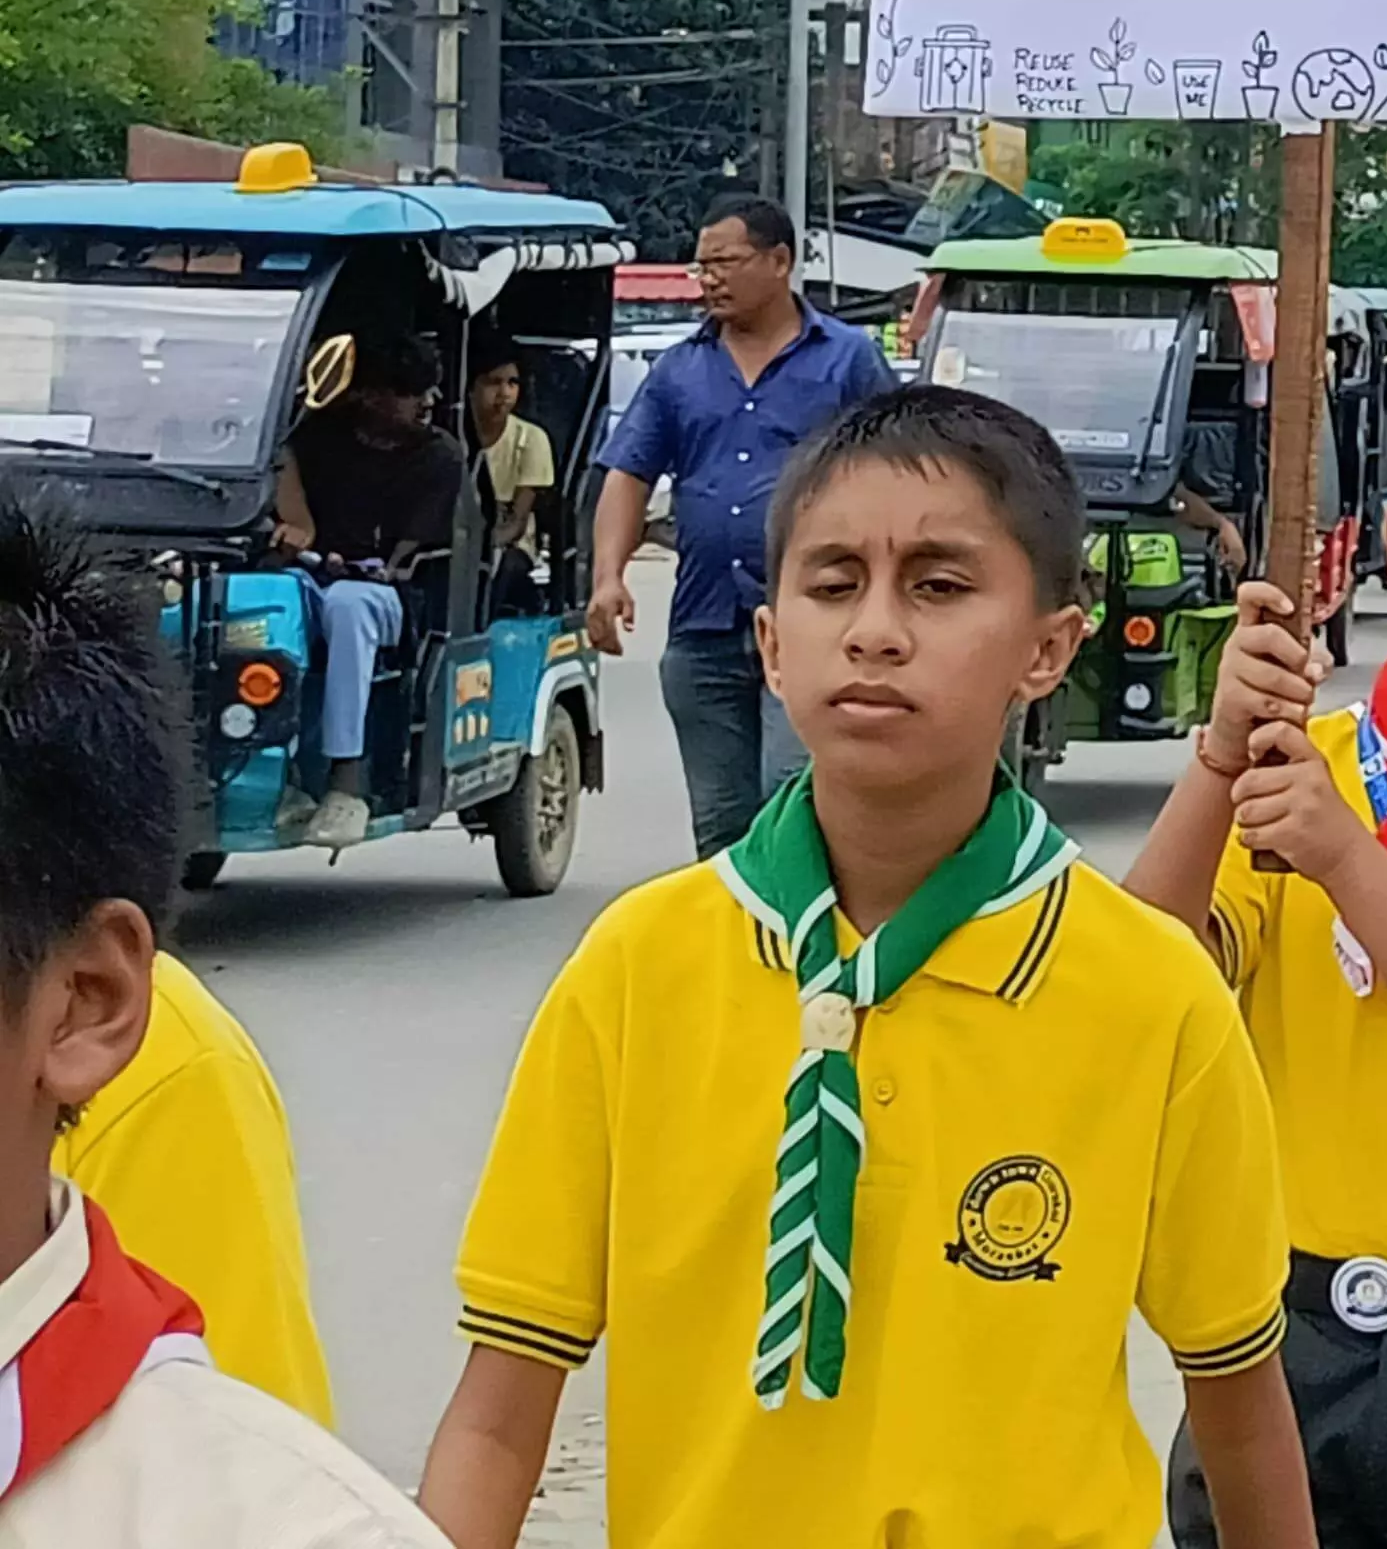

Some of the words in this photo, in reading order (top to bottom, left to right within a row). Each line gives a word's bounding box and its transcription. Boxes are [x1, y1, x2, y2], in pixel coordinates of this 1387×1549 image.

[1014, 48, 1075, 70] REUSE
[1016, 73, 1077, 91] REDUCE
[1181, 74, 1210, 88] USE
[1016, 94, 1087, 113] RECYCLE
[1185, 93, 1208, 107] ME
